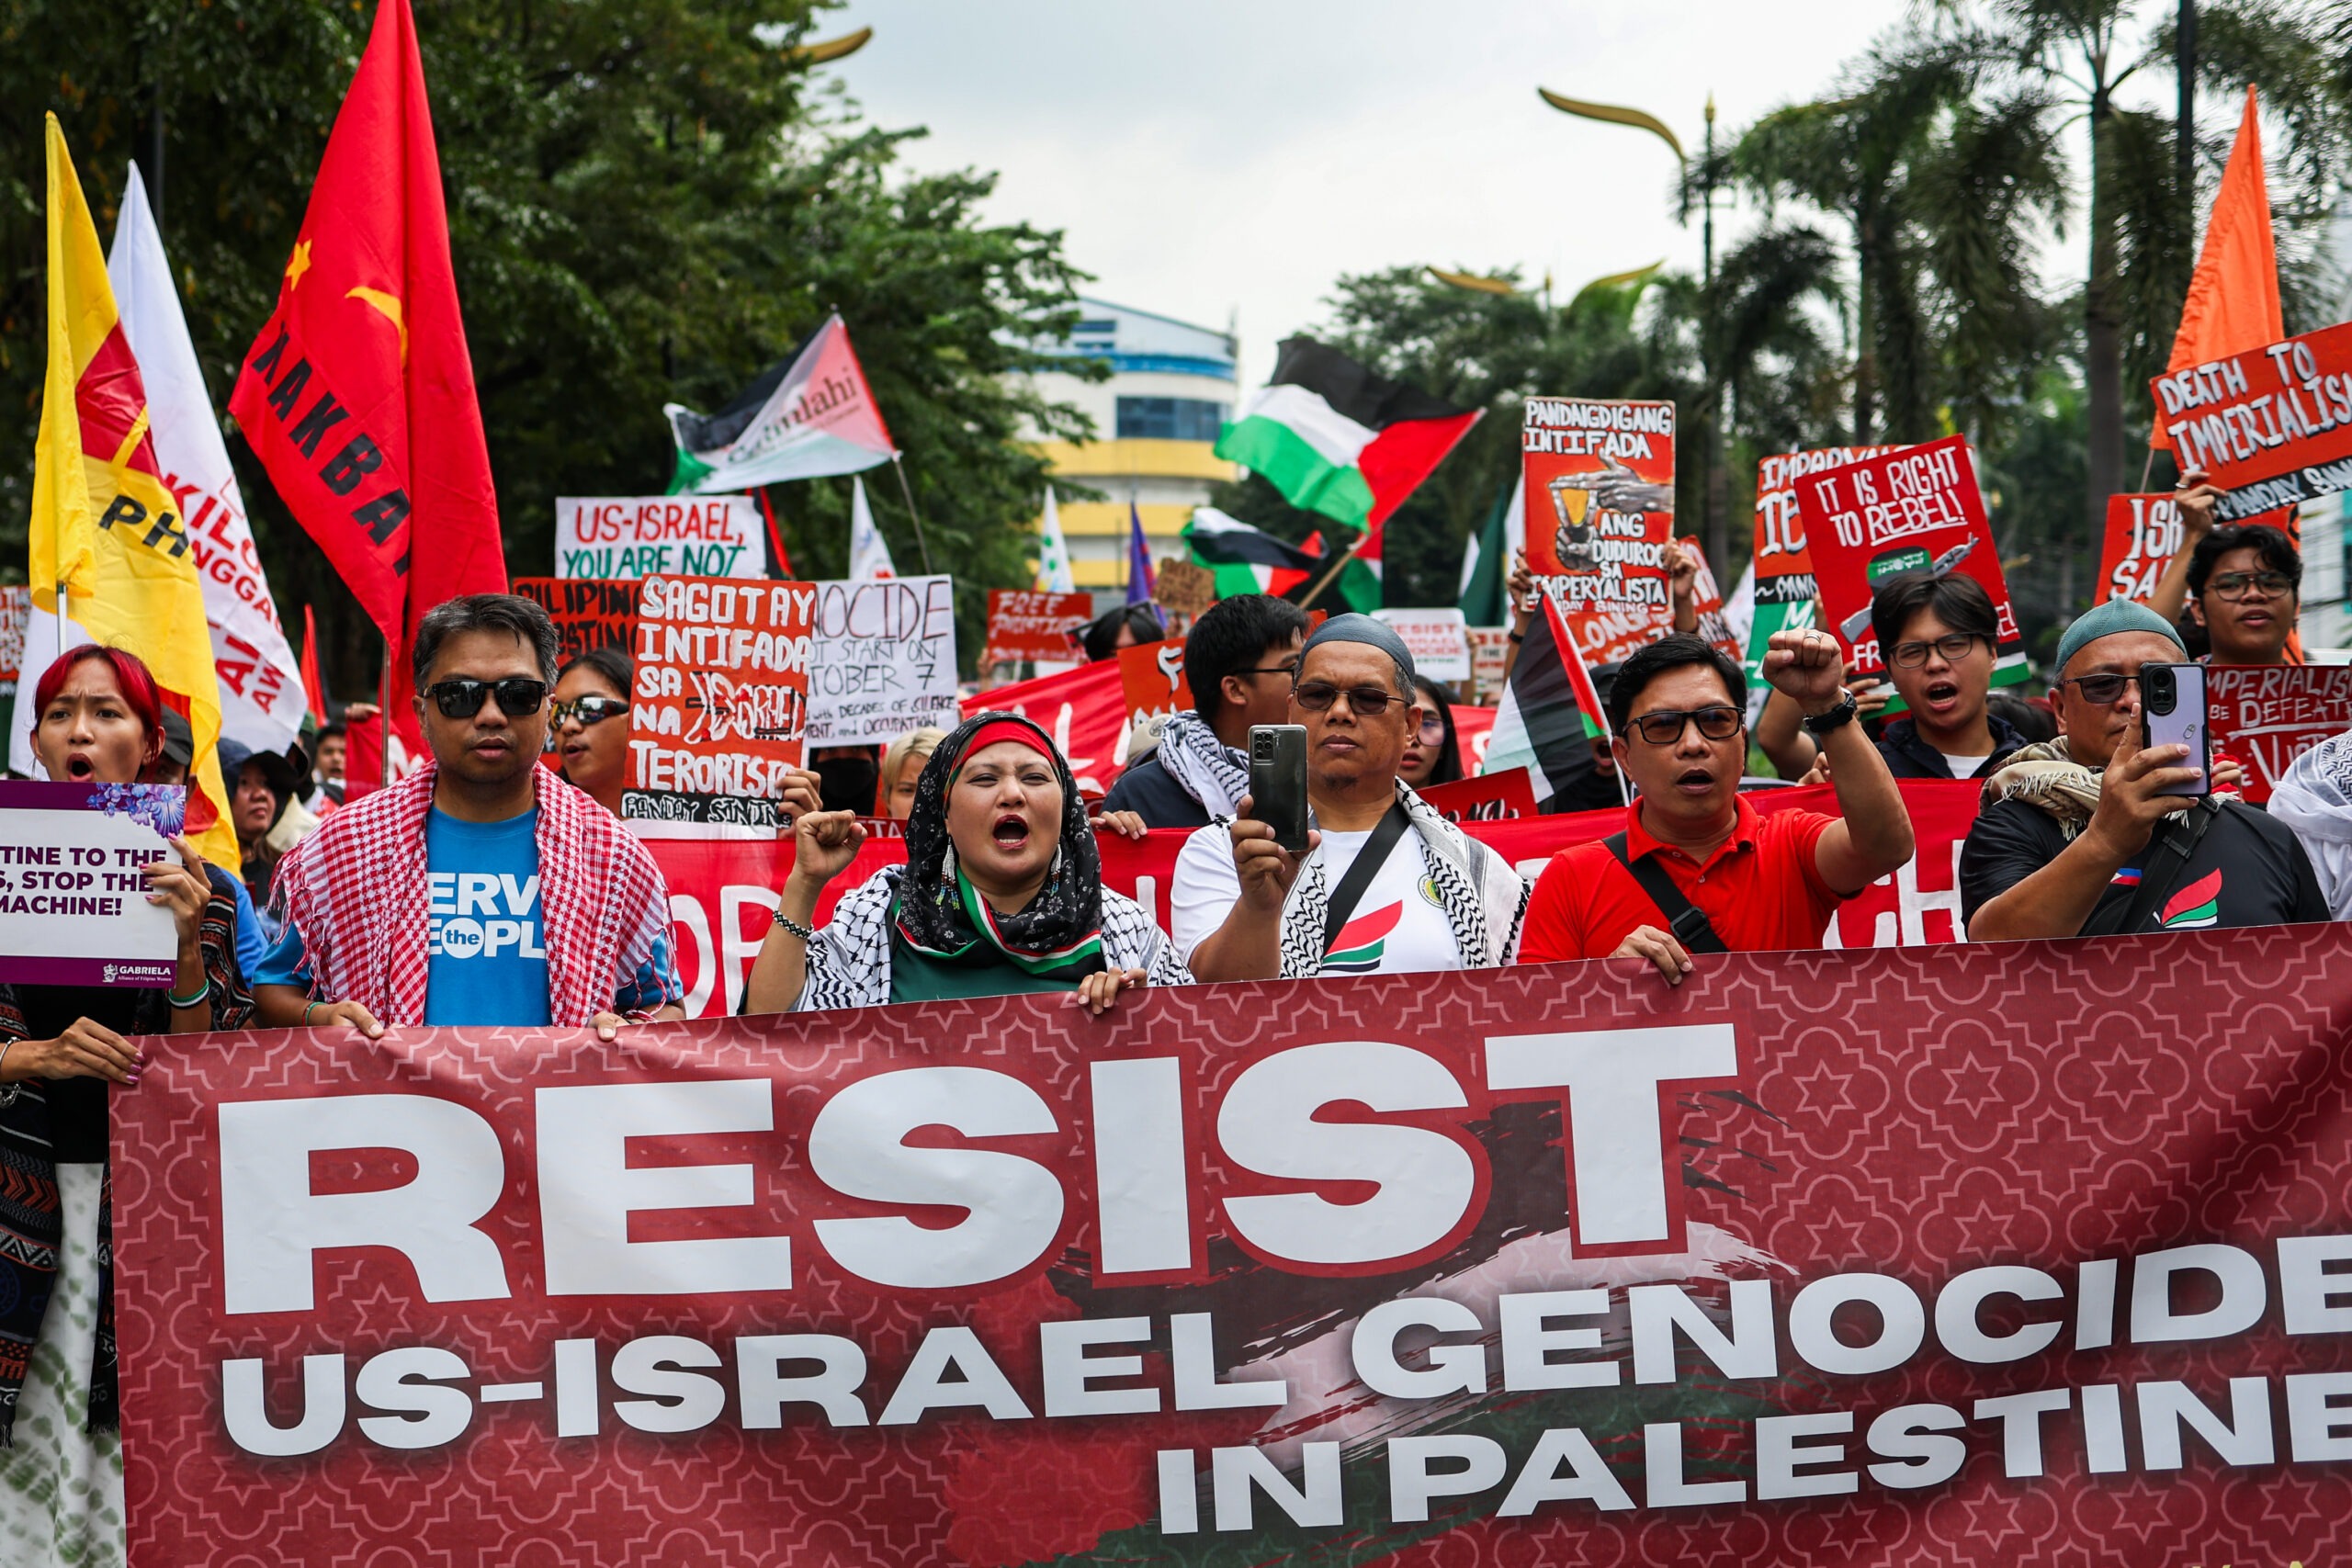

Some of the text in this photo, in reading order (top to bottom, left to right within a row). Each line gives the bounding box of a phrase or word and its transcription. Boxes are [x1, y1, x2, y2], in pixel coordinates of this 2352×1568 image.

[2157, 342, 2316, 414] DEATH TO
[1526, 400, 1672, 435] PANDAIGDIGANG
[1525, 427, 1652, 460] INTIFADA
[1815, 446, 1959, 513] IT IS RIGHT
[575, 503, 744, 545] US-ISRAEL,
[1600, 512, 1645, 537] ANG
[1829, 489, 1966, 547] TO REBEL!
[2126, 498, 2184, 559] ISR
[563, 544, 747, 579] YOU ARE NOT
[1600, 561, 1623, 580] SA
[639, 576, 815, 627] SAGOT AY
[998, 591, 1066, 616] FREE
[639, 623, 812, 675] INTIFADA
[838, 640, 898, 663] START
[907, 638, 936, 661] ON
[637, 665, 682, 697] SA
[809, 672, 936, 696] TOBER 7
[632, 704, 681, 736] NA
[2210, 705, 2230, 720] BE
[69, 848, 107, 866] TO
[22, 871, 93, 891] STOP
[102, 873, 154, 892] THE
[427, 872, 540, 916] ERV
[445, 929, 481, 945] the
[119, 965, 171, 976] GABRIELA
[219, 1022, 1737, 1315] RESIST
[222, 1235, 2352, 1458] US-ISRAEL GENOCIDE
[1159, 1372, 2352, 1535] IN PALESTINE
